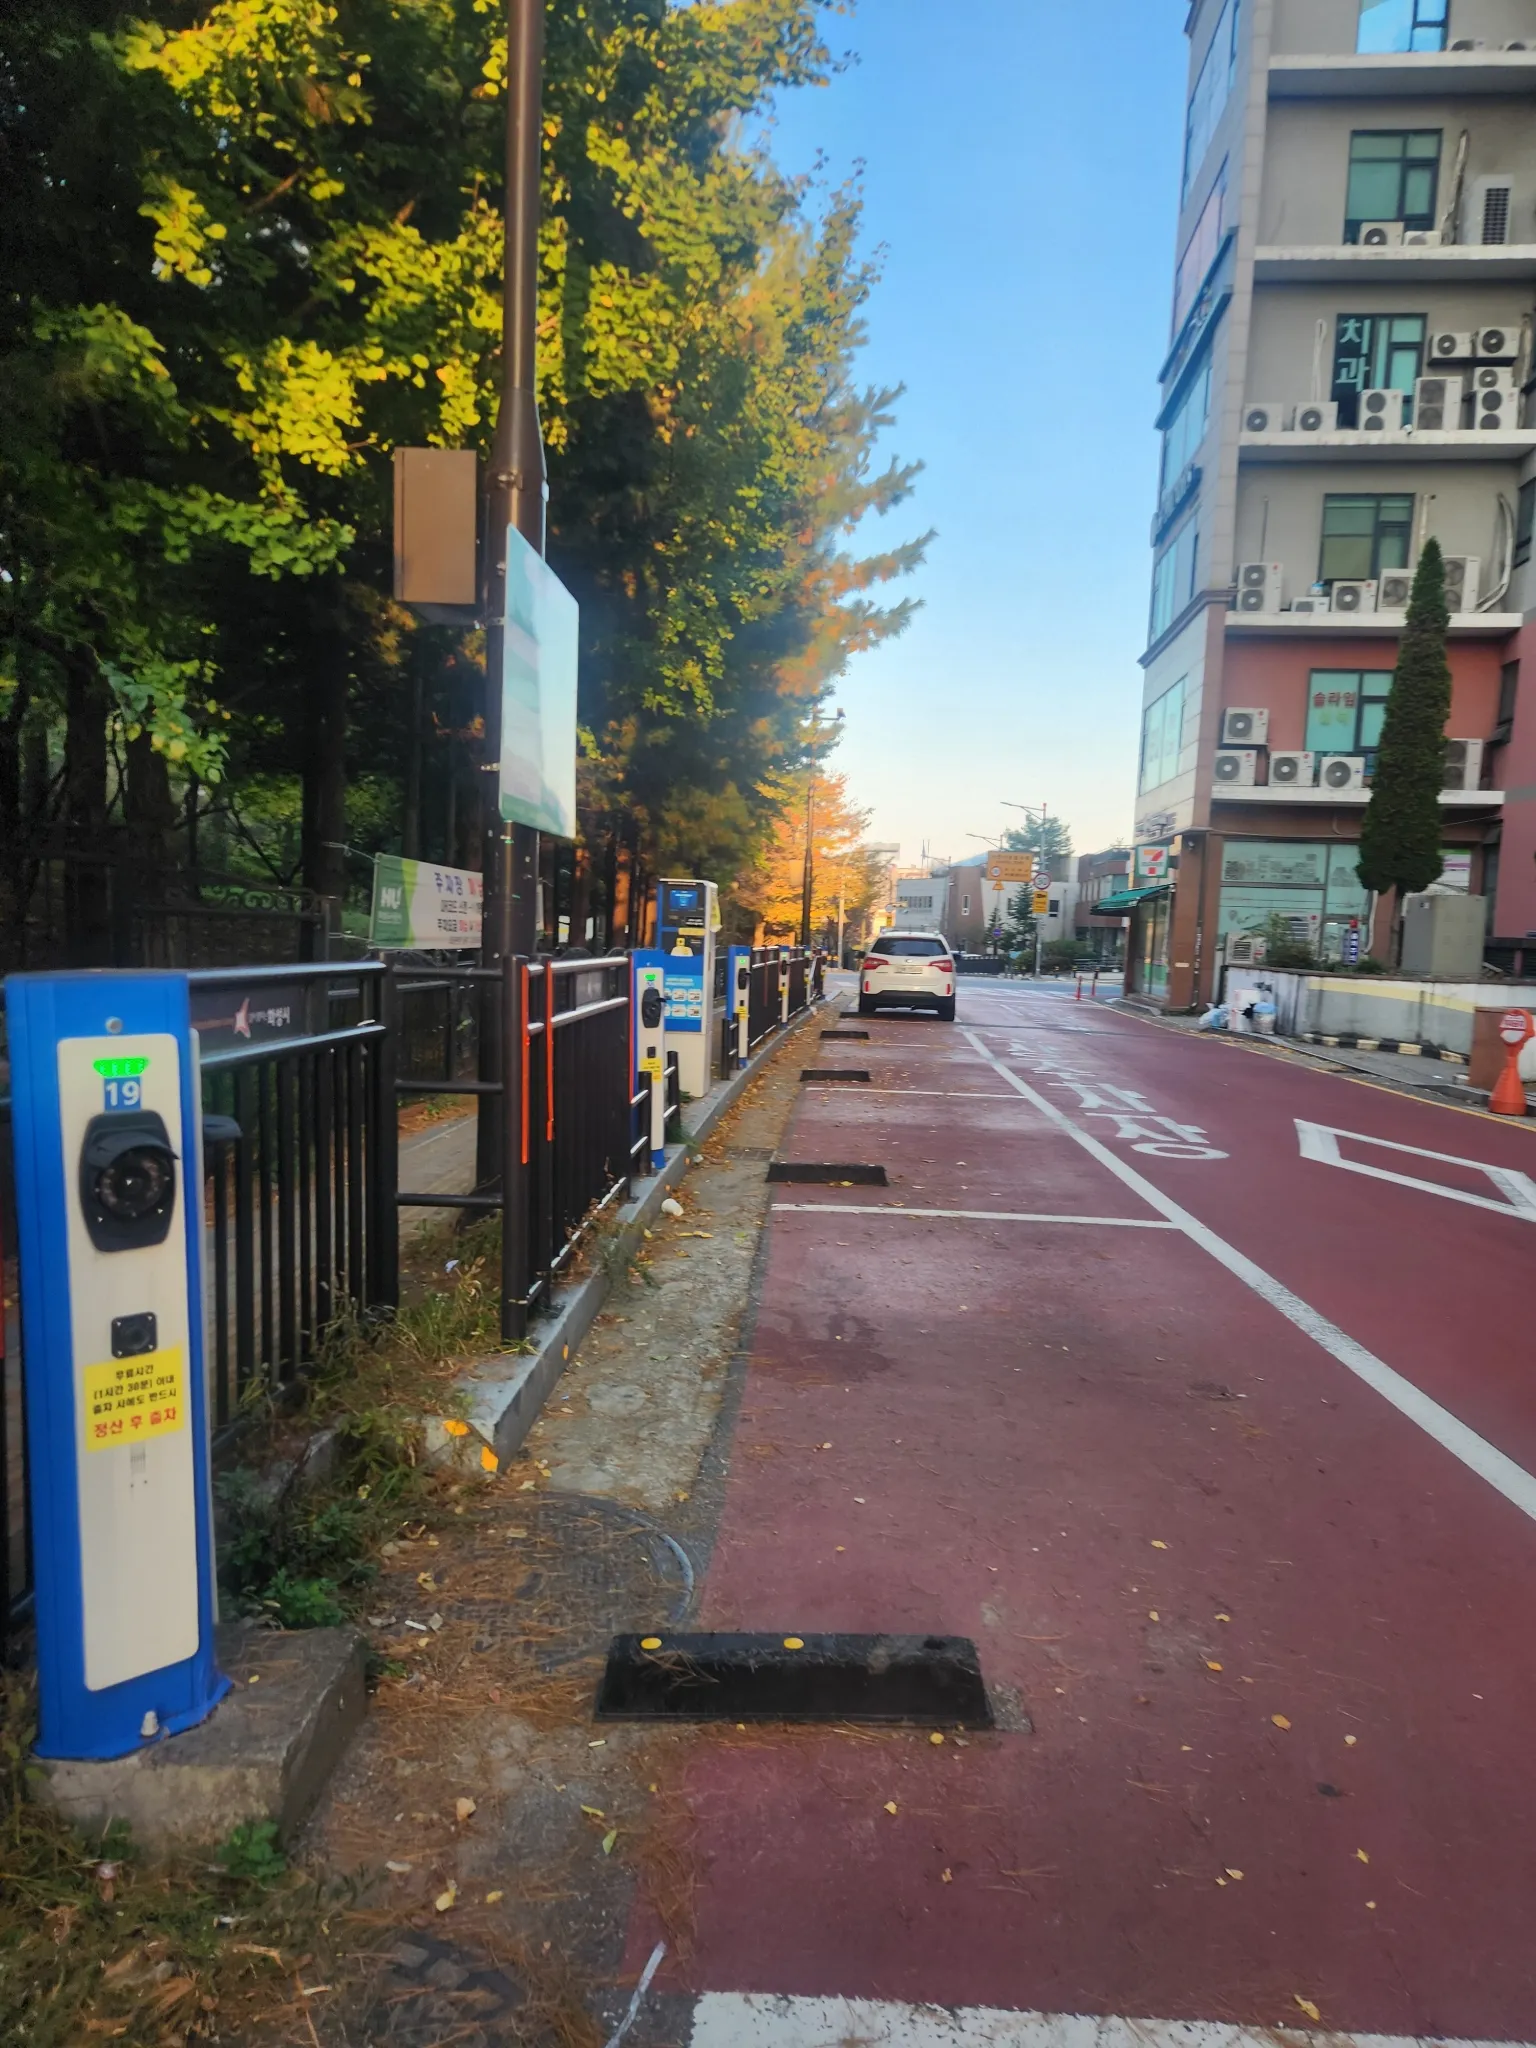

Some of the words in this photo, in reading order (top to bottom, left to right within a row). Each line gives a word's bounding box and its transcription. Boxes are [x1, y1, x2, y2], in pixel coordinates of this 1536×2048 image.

[1335, 318, 1371, 391] 치과
[105, 1081, 141, 1106] 19
[116, 1364, 154, 1380] 무료시간
[156, 1375, 175, 1386] 이내
[93, 1402, 112, 1415] 출차
[116, 1394, 145, 1409] 시에도
[149, 1388, 177, 1402] 반드시
[94, 1419, 123, 1438] 정산
[130, 1415, 142, 1429] 후
[150, 1406, 176, 1425] 출차
